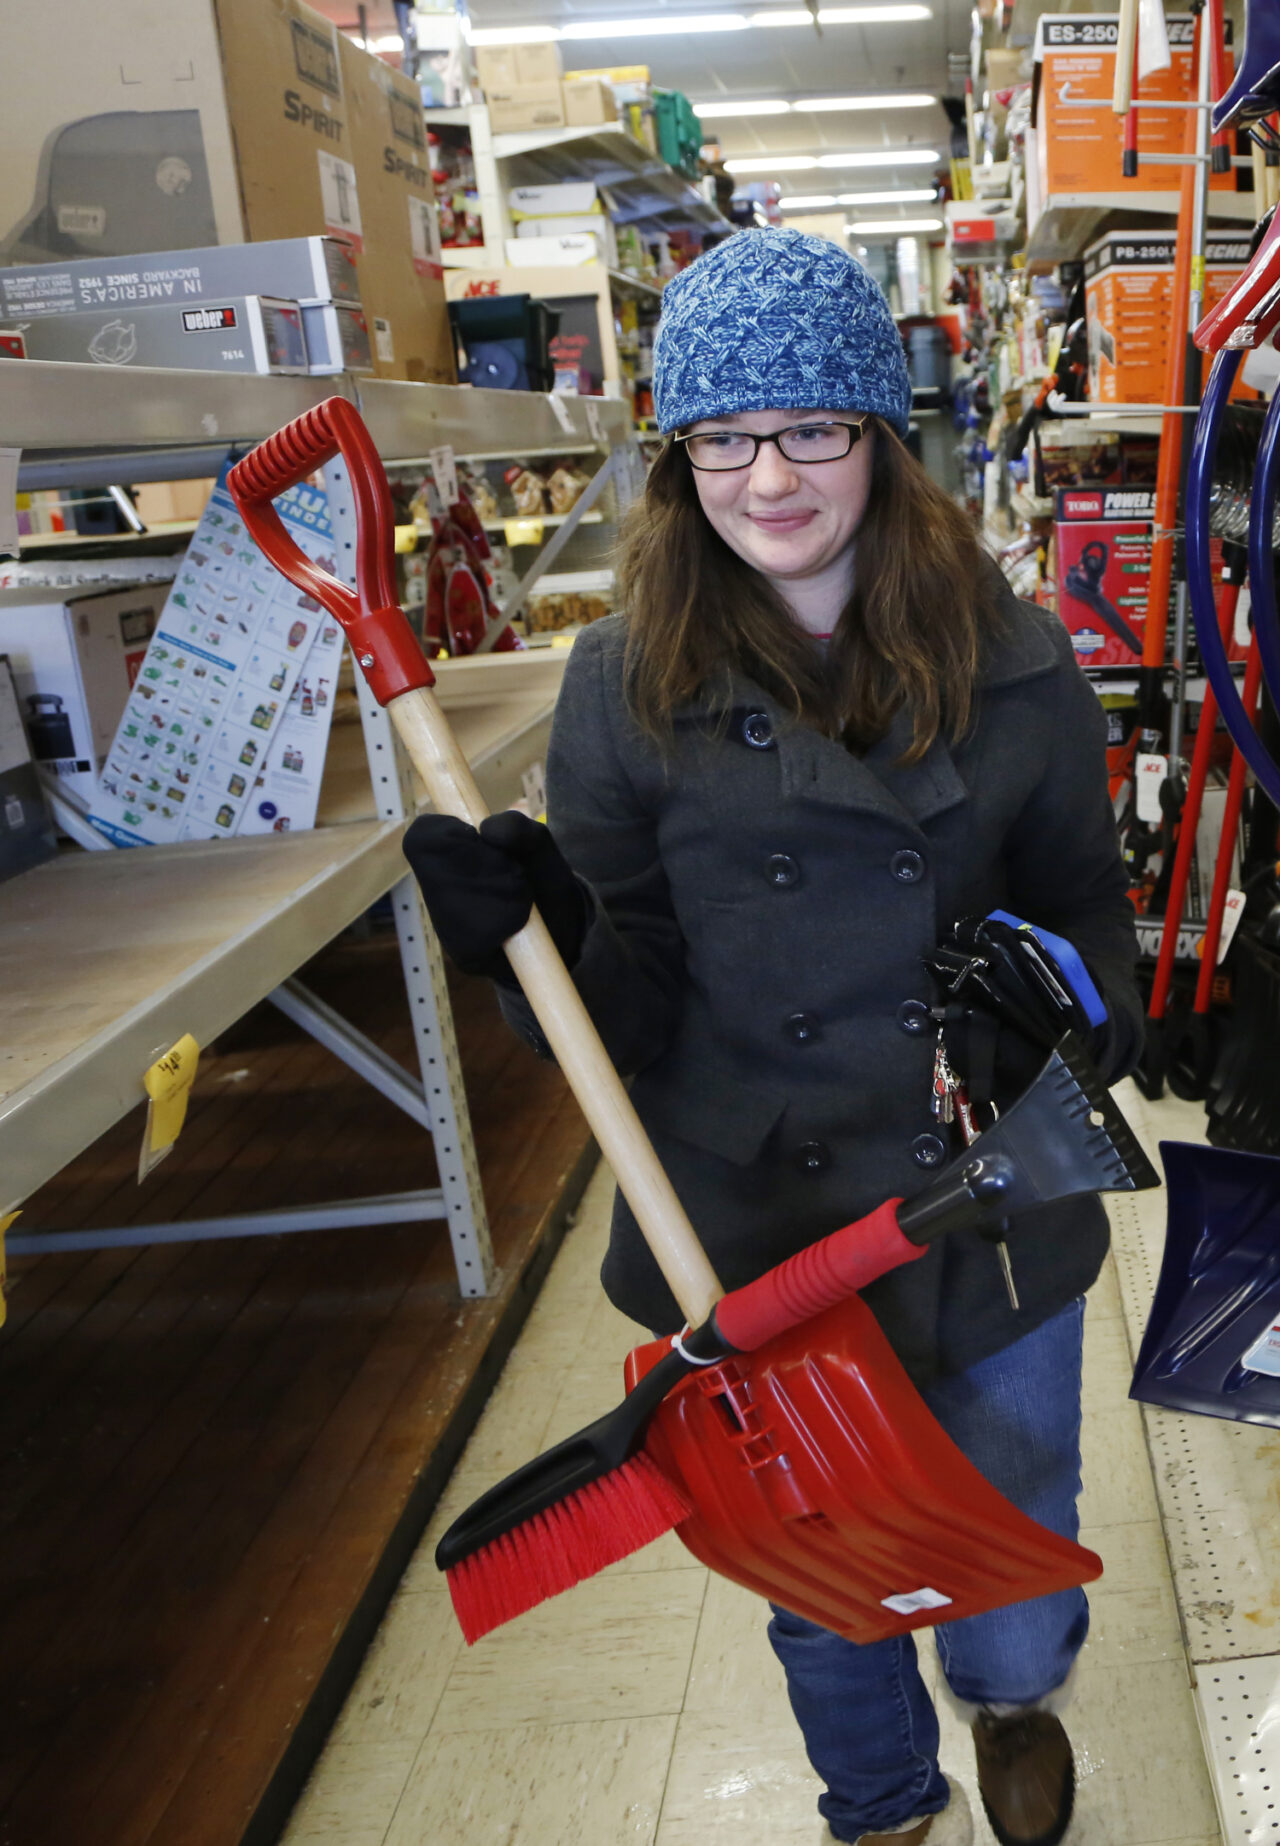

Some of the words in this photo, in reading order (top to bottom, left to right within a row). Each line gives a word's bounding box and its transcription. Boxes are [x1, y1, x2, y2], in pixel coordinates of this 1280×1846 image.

[1050, 25, 1118, 42] ES-250
[284, 88, 344, 143] SPIRIT
[1205, 244, 1250, 259] ECHO
[79, 277, 103, 289] 1952
[106, 273, 139, 286] SINCE
[142, 267, 200, 283] BACKYARD
[81, 281, 174, 304] AMERICA'S
[184, 279, 202, 294] IN
[465, 280, 500, 297] ACE
[185, 308, 223, 330] weber
[1066, 501, 1099, 512] TORO
[1105, 492, 1150, 508] POWER
